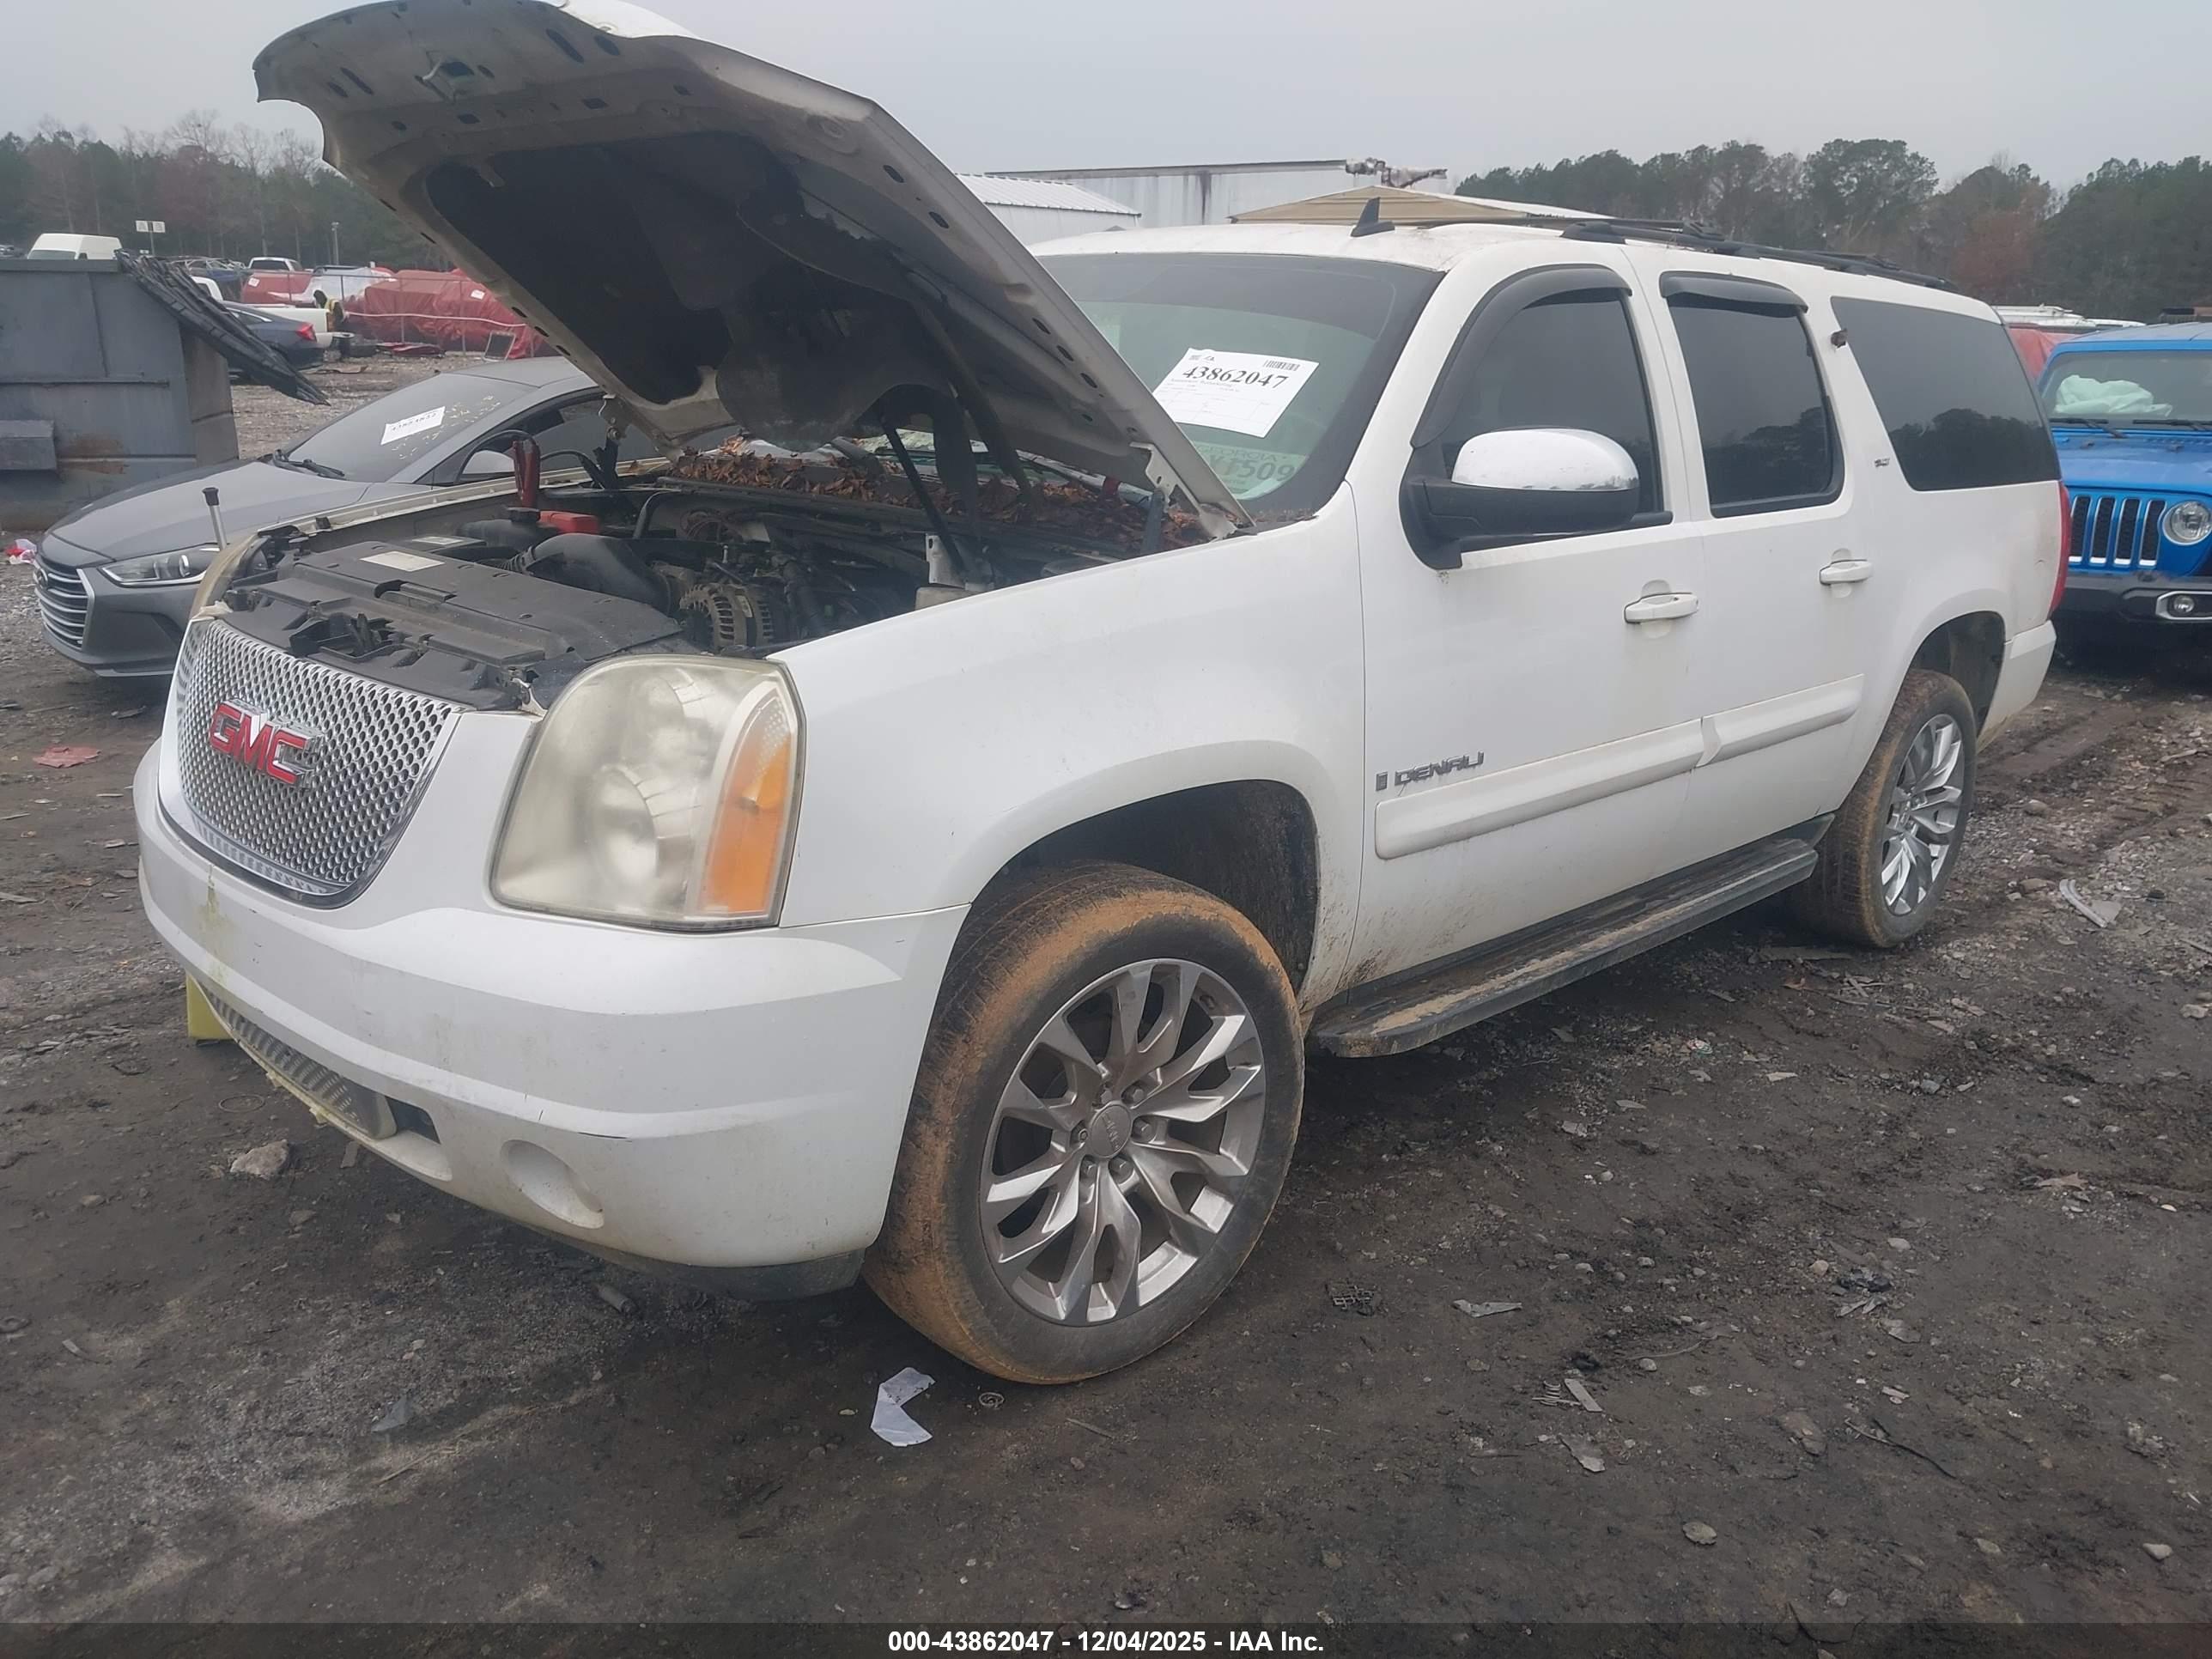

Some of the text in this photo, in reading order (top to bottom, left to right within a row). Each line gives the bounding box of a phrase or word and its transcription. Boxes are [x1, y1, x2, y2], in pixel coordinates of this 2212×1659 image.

[1182, 365, 1289, 389] 43862047
[210, 699, 314, 785] GMC
[1394, 750, 1485, 787] DENALI
